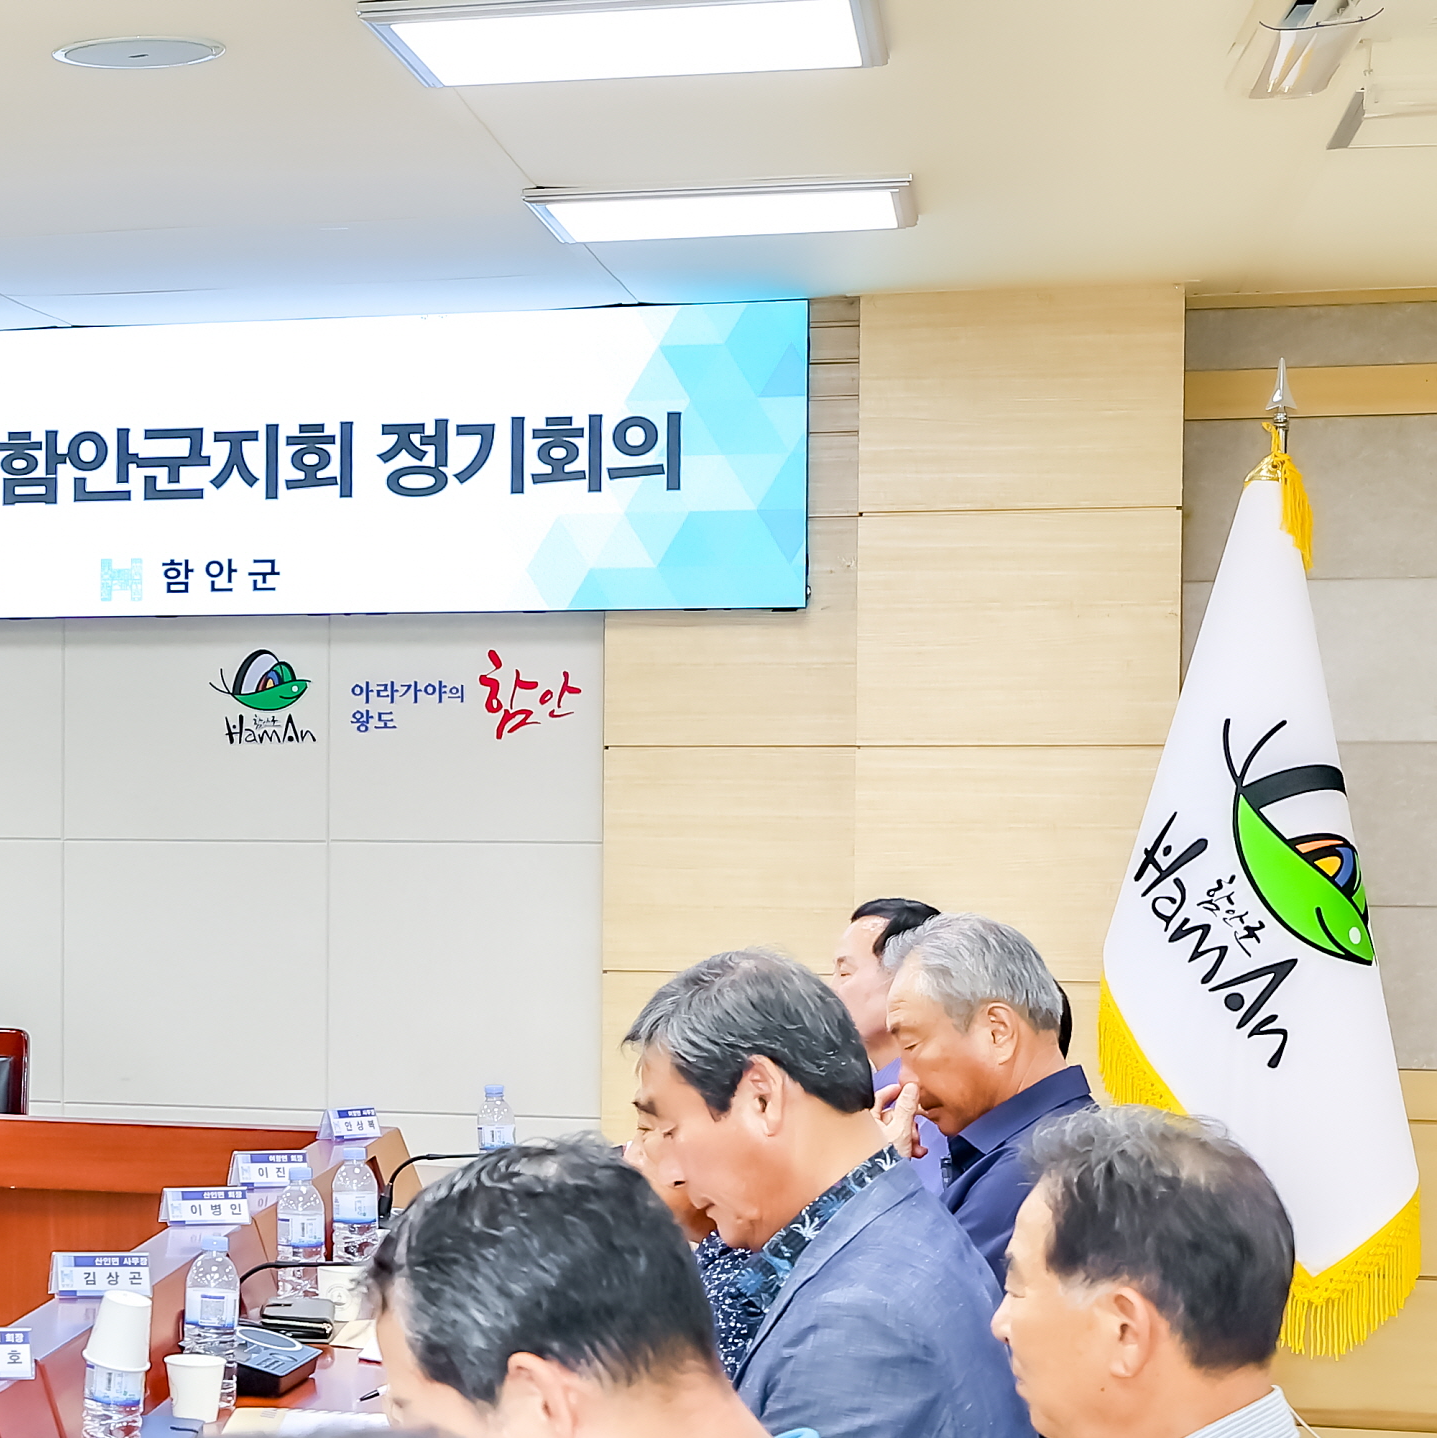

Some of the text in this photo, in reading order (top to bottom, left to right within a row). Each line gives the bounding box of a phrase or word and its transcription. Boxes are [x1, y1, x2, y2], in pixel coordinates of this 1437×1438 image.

[376, 410, 683, 498] 정기회의
[350, 680, 465, 704] 아라가야의
[478, 648, 582, 740] 함안
[350, 709, 397, 733] 왕도
[257, 1166, 286, 1179] 이진
[190, 1203, 242, 1217] 이병인
[83, 1271, 143, 1286] 김상곤
[5, 1332, 24, 1343] 회장
